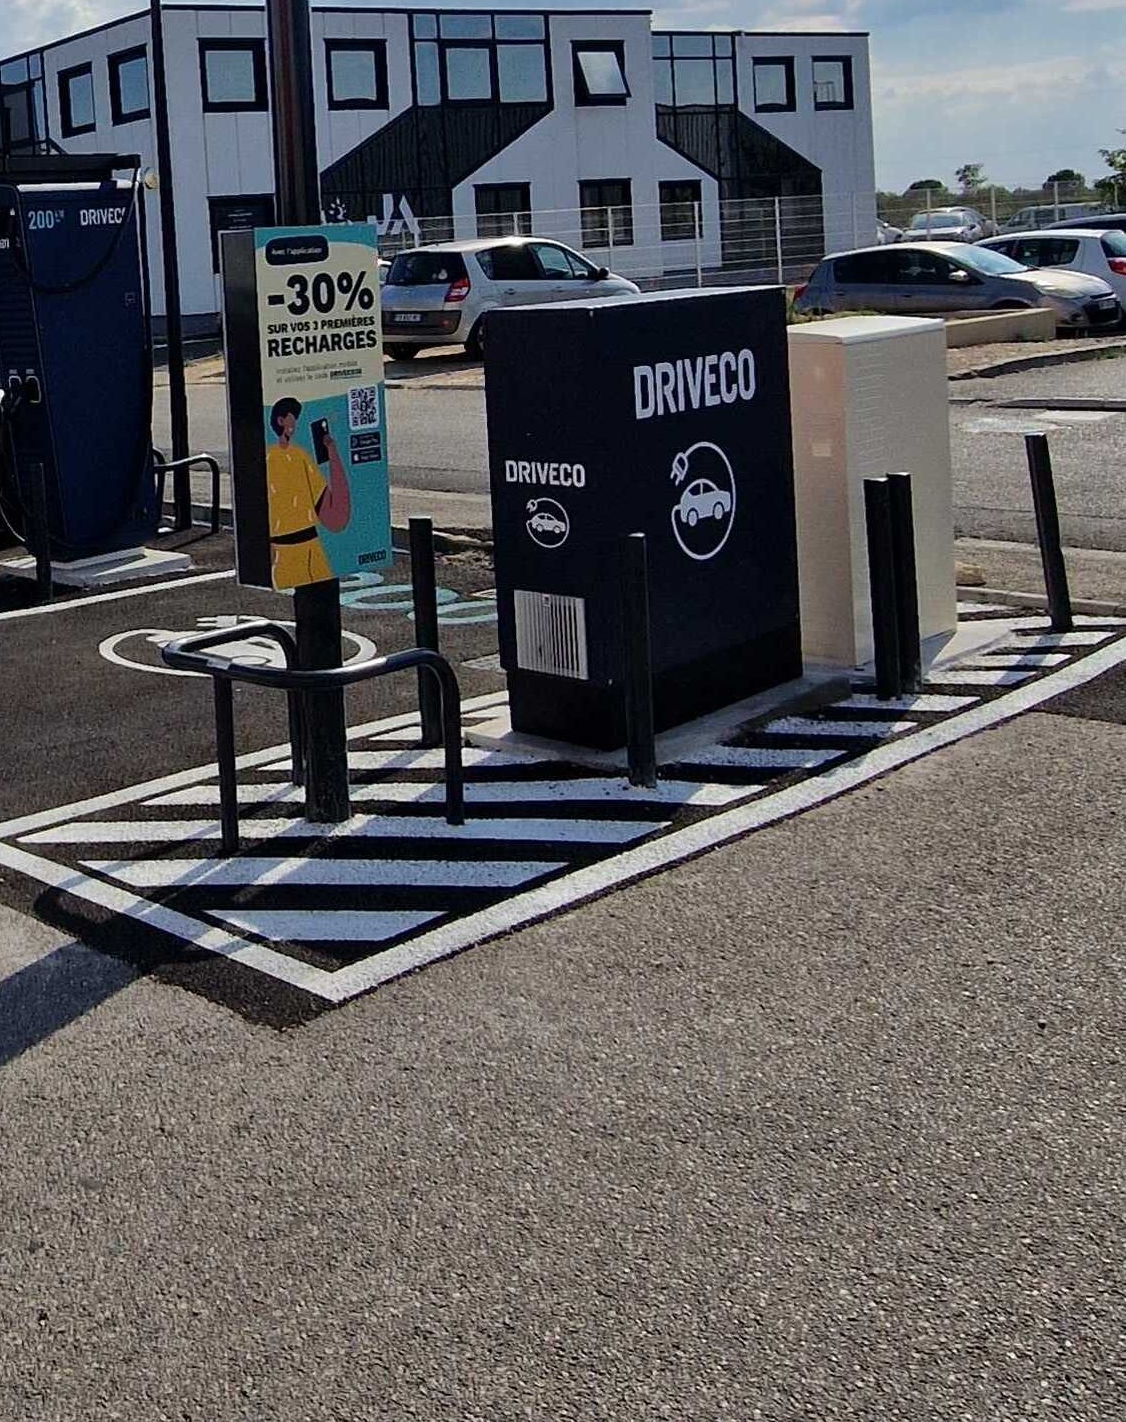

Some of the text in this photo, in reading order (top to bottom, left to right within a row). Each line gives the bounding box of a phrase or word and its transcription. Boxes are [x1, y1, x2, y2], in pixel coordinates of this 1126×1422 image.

[267, 270, 375, 316] -30%
[267, 315, 376, 335] SUR VOS 3 PREMIÈRES
[267, 329, 377, 358] RECHARGES
[633, 348, 757, 420] DRIVECO
[505, 459, 586, 488] DRIVECO
